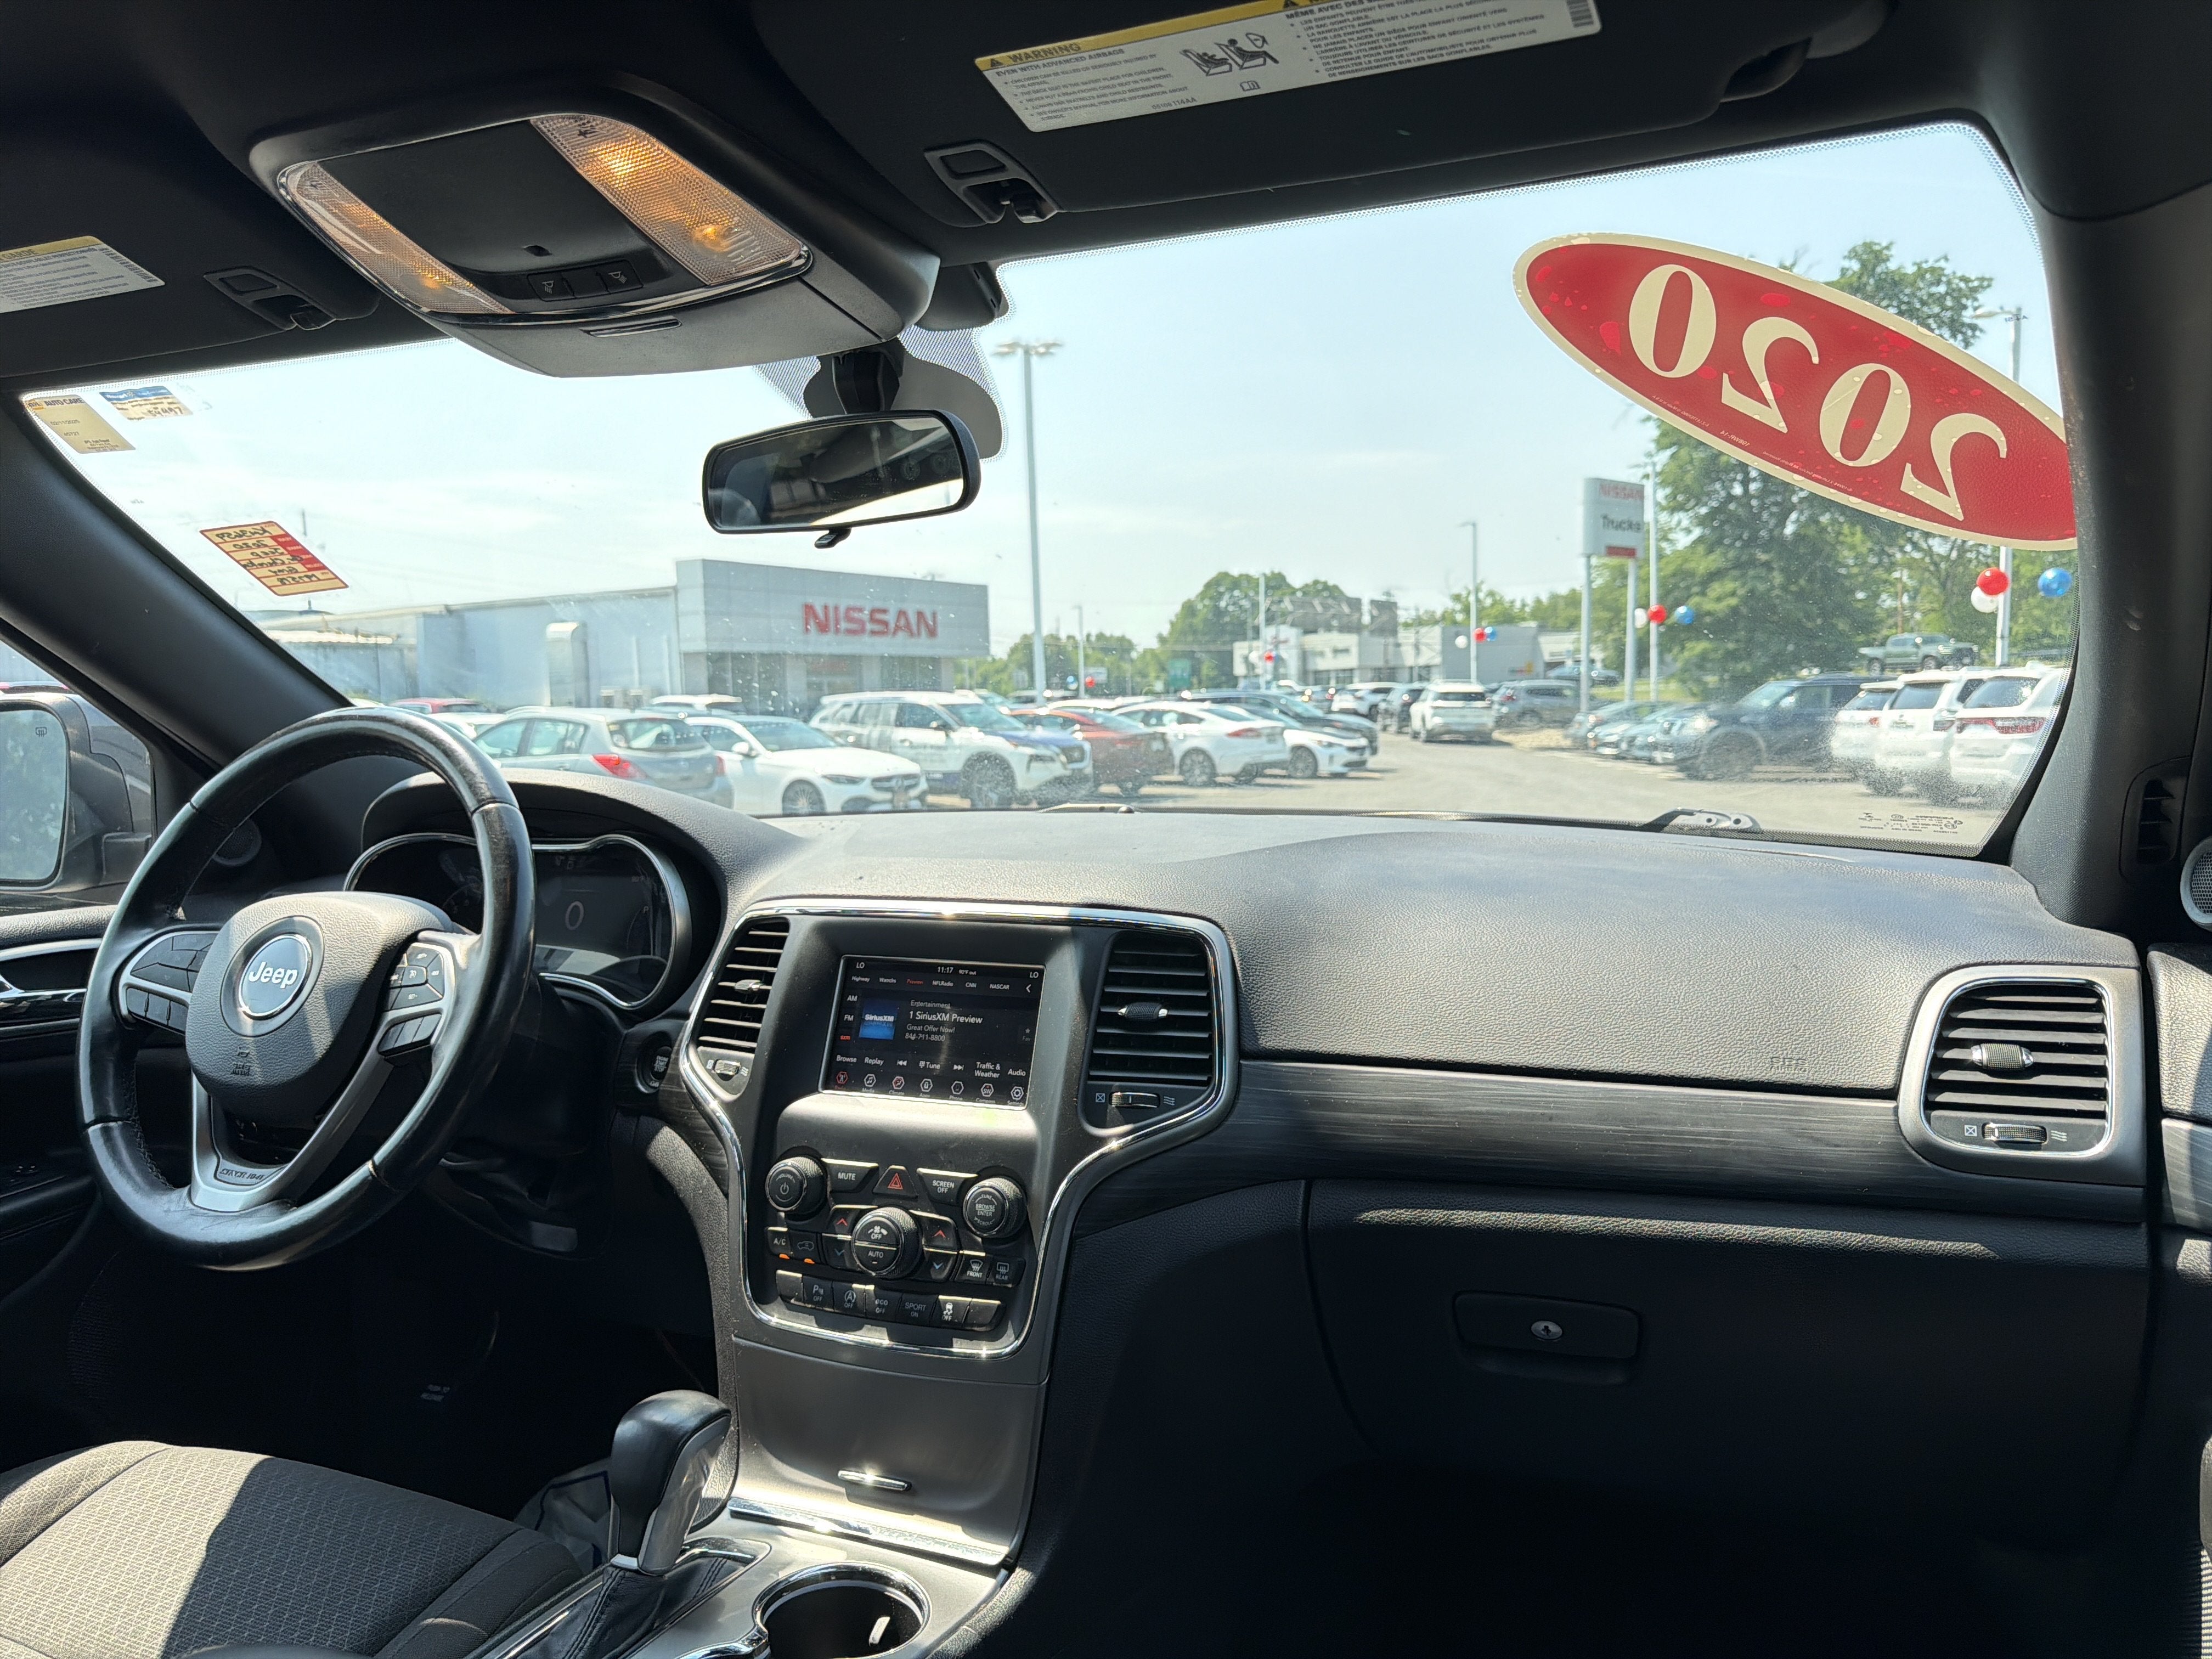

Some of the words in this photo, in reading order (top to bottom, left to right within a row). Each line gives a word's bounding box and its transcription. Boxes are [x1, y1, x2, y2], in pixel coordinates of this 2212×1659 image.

[1008, 43, 1081, 63] WARNING
[995, 68, 1018, 76] EVEN
[1017, 64, 1041, 72] WITH
[1040, 55, 1087, 68] ADVANCED
[1086, 48, 1125, 60] AIRBAGS
[65, 398, 84, 406] CARE
[1601, 514, 1641, 533] Trucks
[803, 602, 939, 638] NISSAN
[249, 961, 298, 989] Jeep
[910, 1000, 951, 1008] Entertainment
[865, 1014, 894, 1022] SiriusXM
[909, 1011, 913, 1019] 1
[916, 1011, 949, 1022] SiriusXM
[951, 1013, 983, 1024] Preview
[905, 1032, 946, 1042] 844-711-8800
[836, 1054, 857, 1063] Browse
[864, 1057, 884, 1066] Replay
[926, 1062, 941, 1070] Tune
[975, 1062, 995, 1070] Traffic
[974, 1070, 1000, 1078] Weather
[838, 1172, 856, 1181] MUTE
[933, 1180, 955, 1189] SCREEN
[774, 1237, 787, 1245] A/C
[868, 1250, 884, 1258] AUTO
[905, 1302, 927, 1311] SPORT
